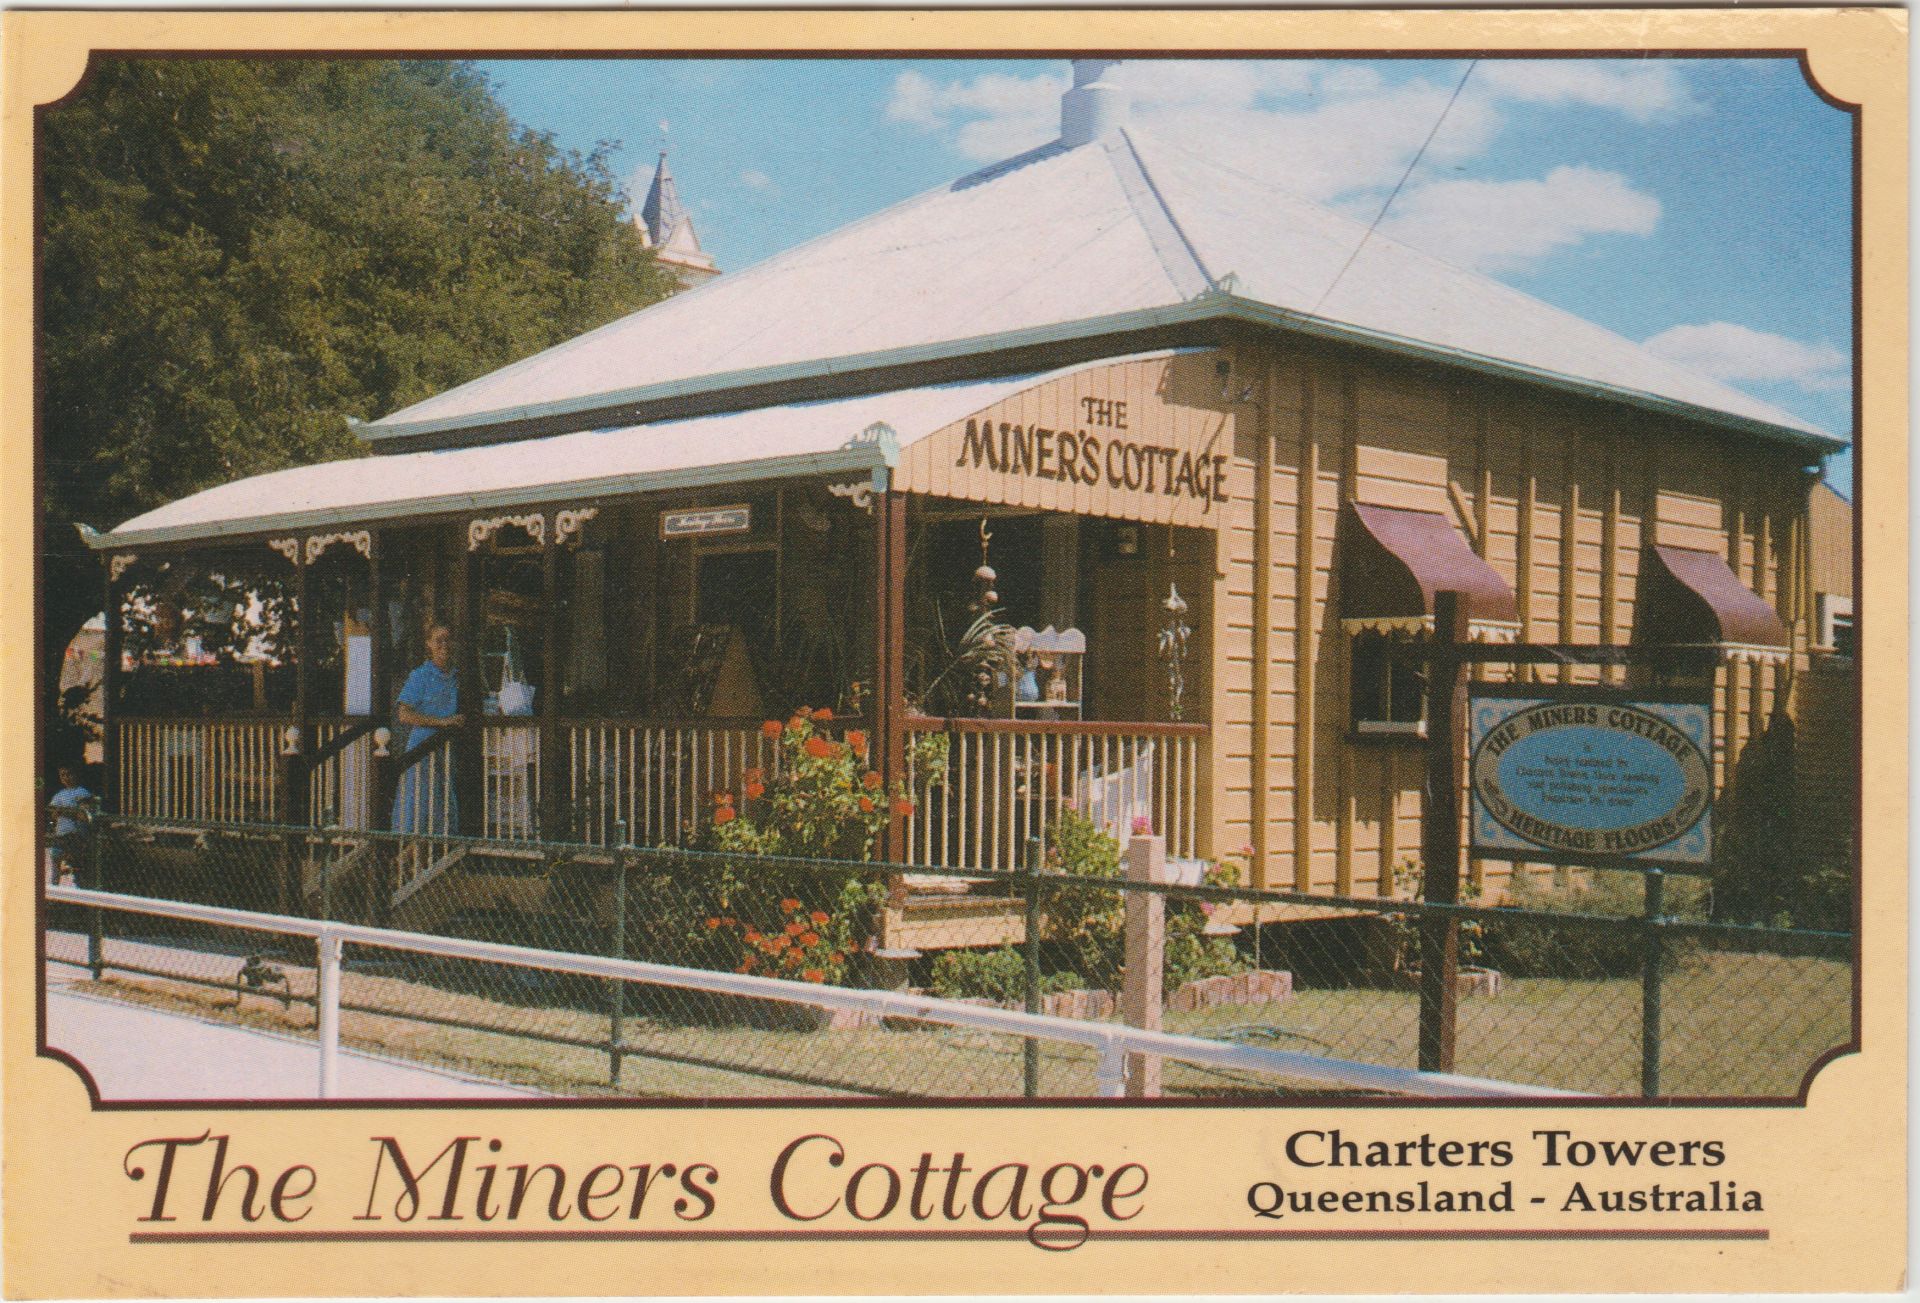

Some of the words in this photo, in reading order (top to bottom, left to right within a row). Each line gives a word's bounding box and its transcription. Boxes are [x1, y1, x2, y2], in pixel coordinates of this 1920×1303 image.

[1080, 395, 1128, 430] THE
[956, 417, 1101, 487] MINER'S
[1106, 437, 1229, 515] COTTAGE
[1485, 723, 1522, 757] THE
[1527, 706, 1599, 732] MINERS
[1608, 709, 1696, 762] COTTAGE
[1509, 808, 1596, 850] HERITAGE
[1603, 816, 1678, 850] FLOORS
